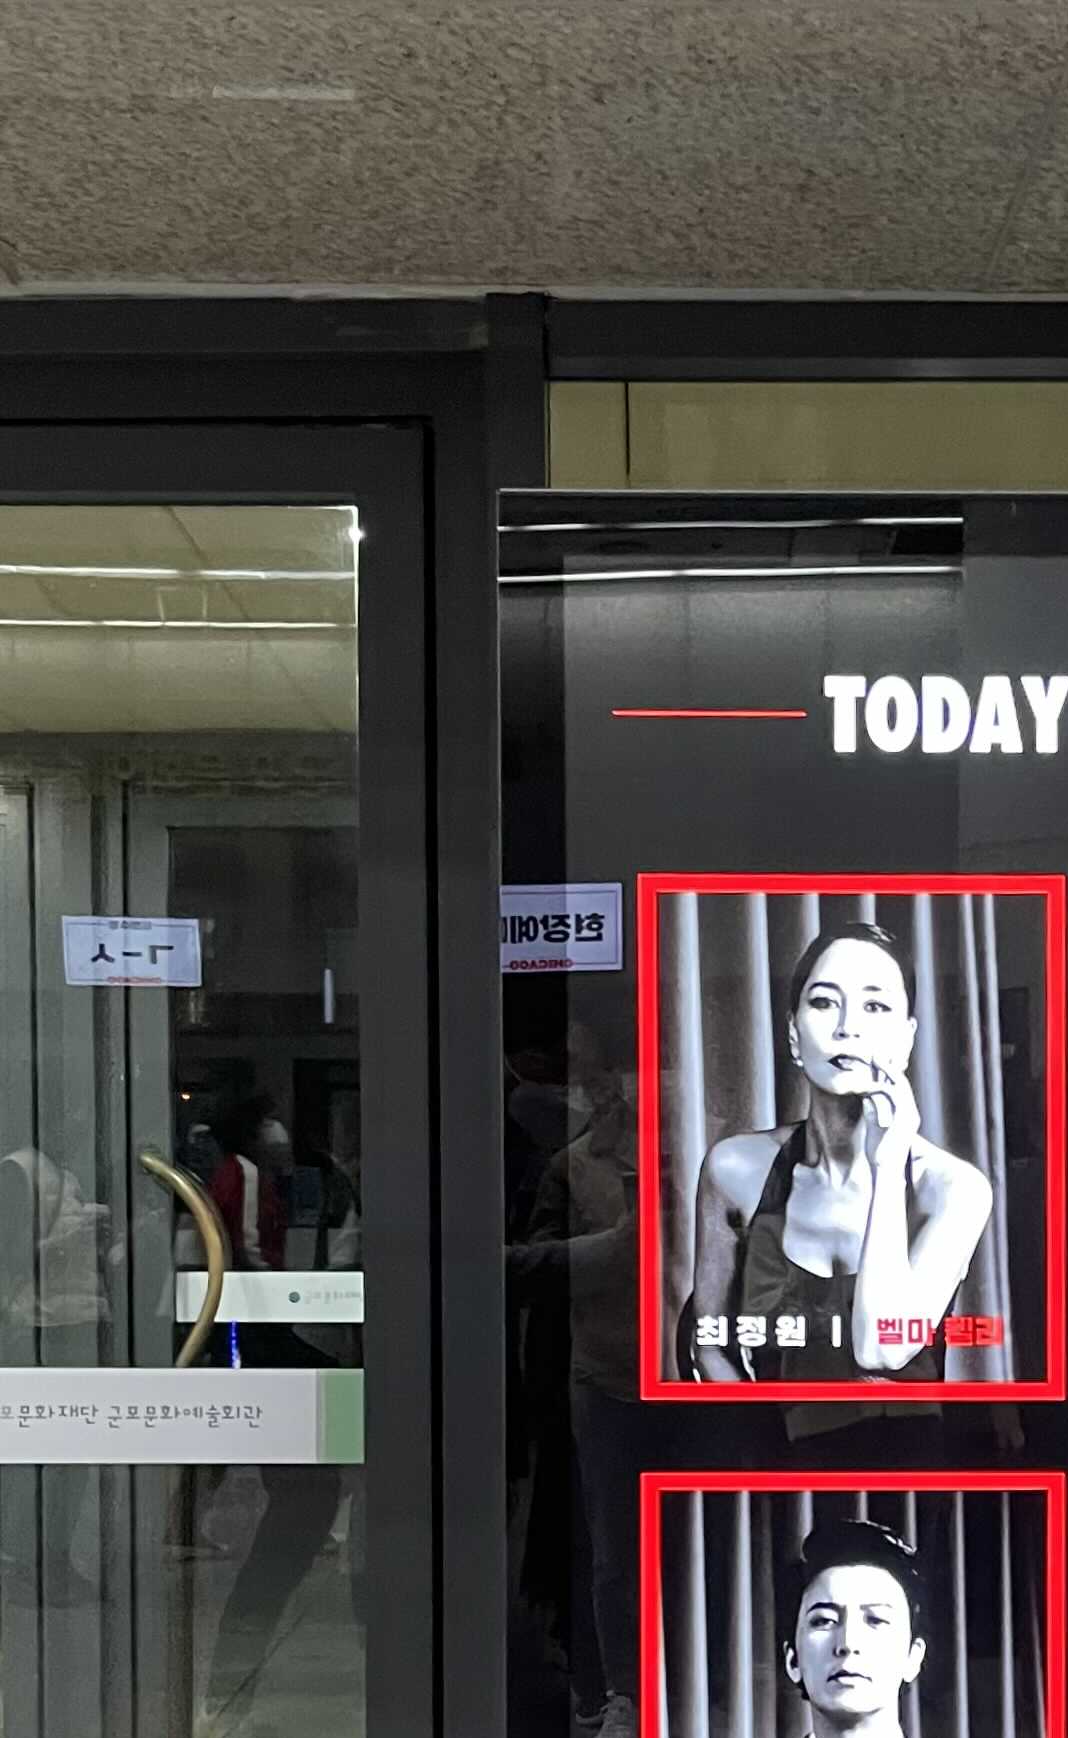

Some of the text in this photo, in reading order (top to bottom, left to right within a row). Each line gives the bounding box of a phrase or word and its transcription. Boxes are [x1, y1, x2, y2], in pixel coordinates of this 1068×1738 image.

[877, 1317, 936, 1346] 벨마
[944, 1316, 1005, 1347] 켈리
[107, 1405, 263, 1428] 군포문화예술회관
